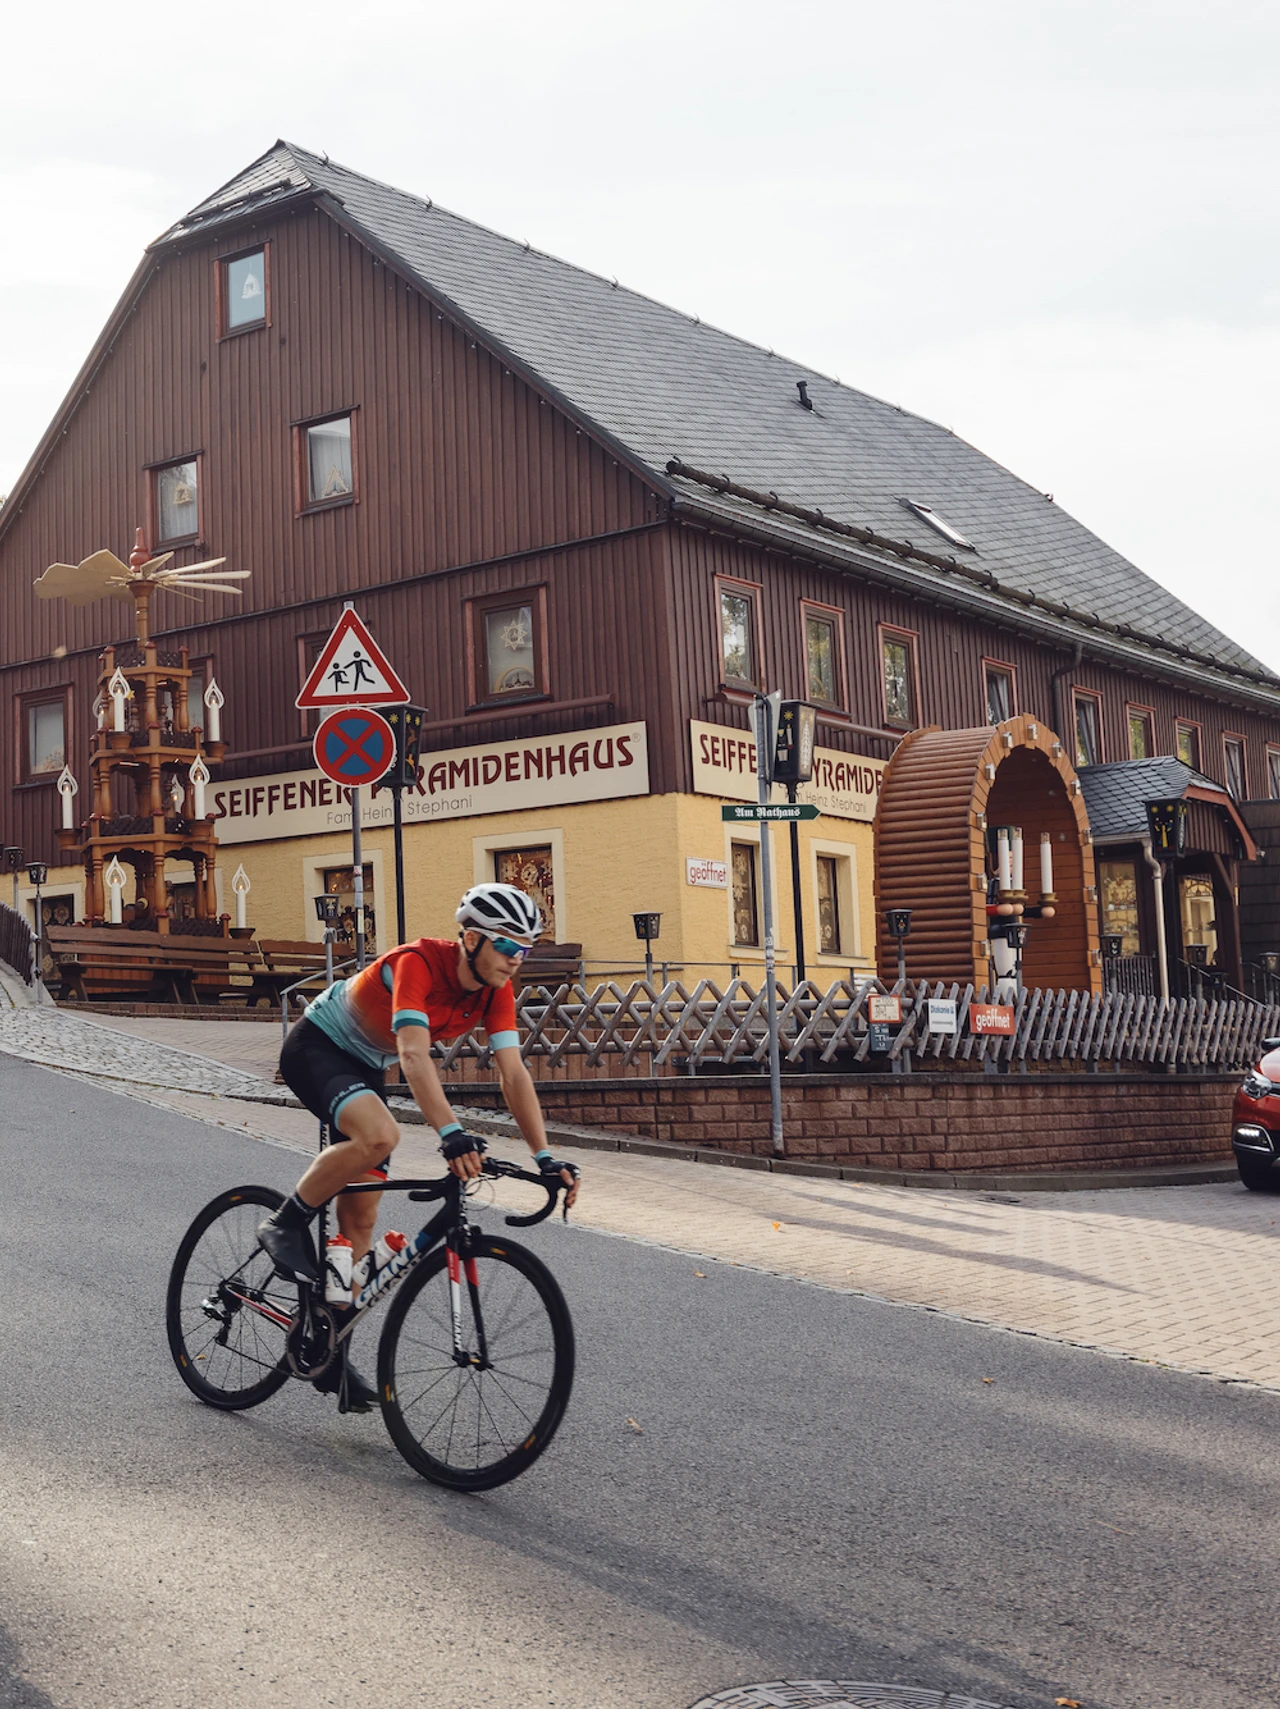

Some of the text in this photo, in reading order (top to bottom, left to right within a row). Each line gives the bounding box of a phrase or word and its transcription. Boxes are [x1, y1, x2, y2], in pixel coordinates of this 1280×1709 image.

[699, 733, 757, 774] SEIFFE
[214, 735, 634, 819] SEIFFENER RAMIDENHAUS
[362, 806, 393, 820] Hein
[407, 795, 473, 815] Stephani
[734, 807, 801, 819] Am Rathaus
[831, 795, 867, 813] Stephani
[689, 861, 727, 885] geöffnet
[975, 1008, 1010, 1031] geöffnet
[355, 1241, 418, 1310] GIANT
